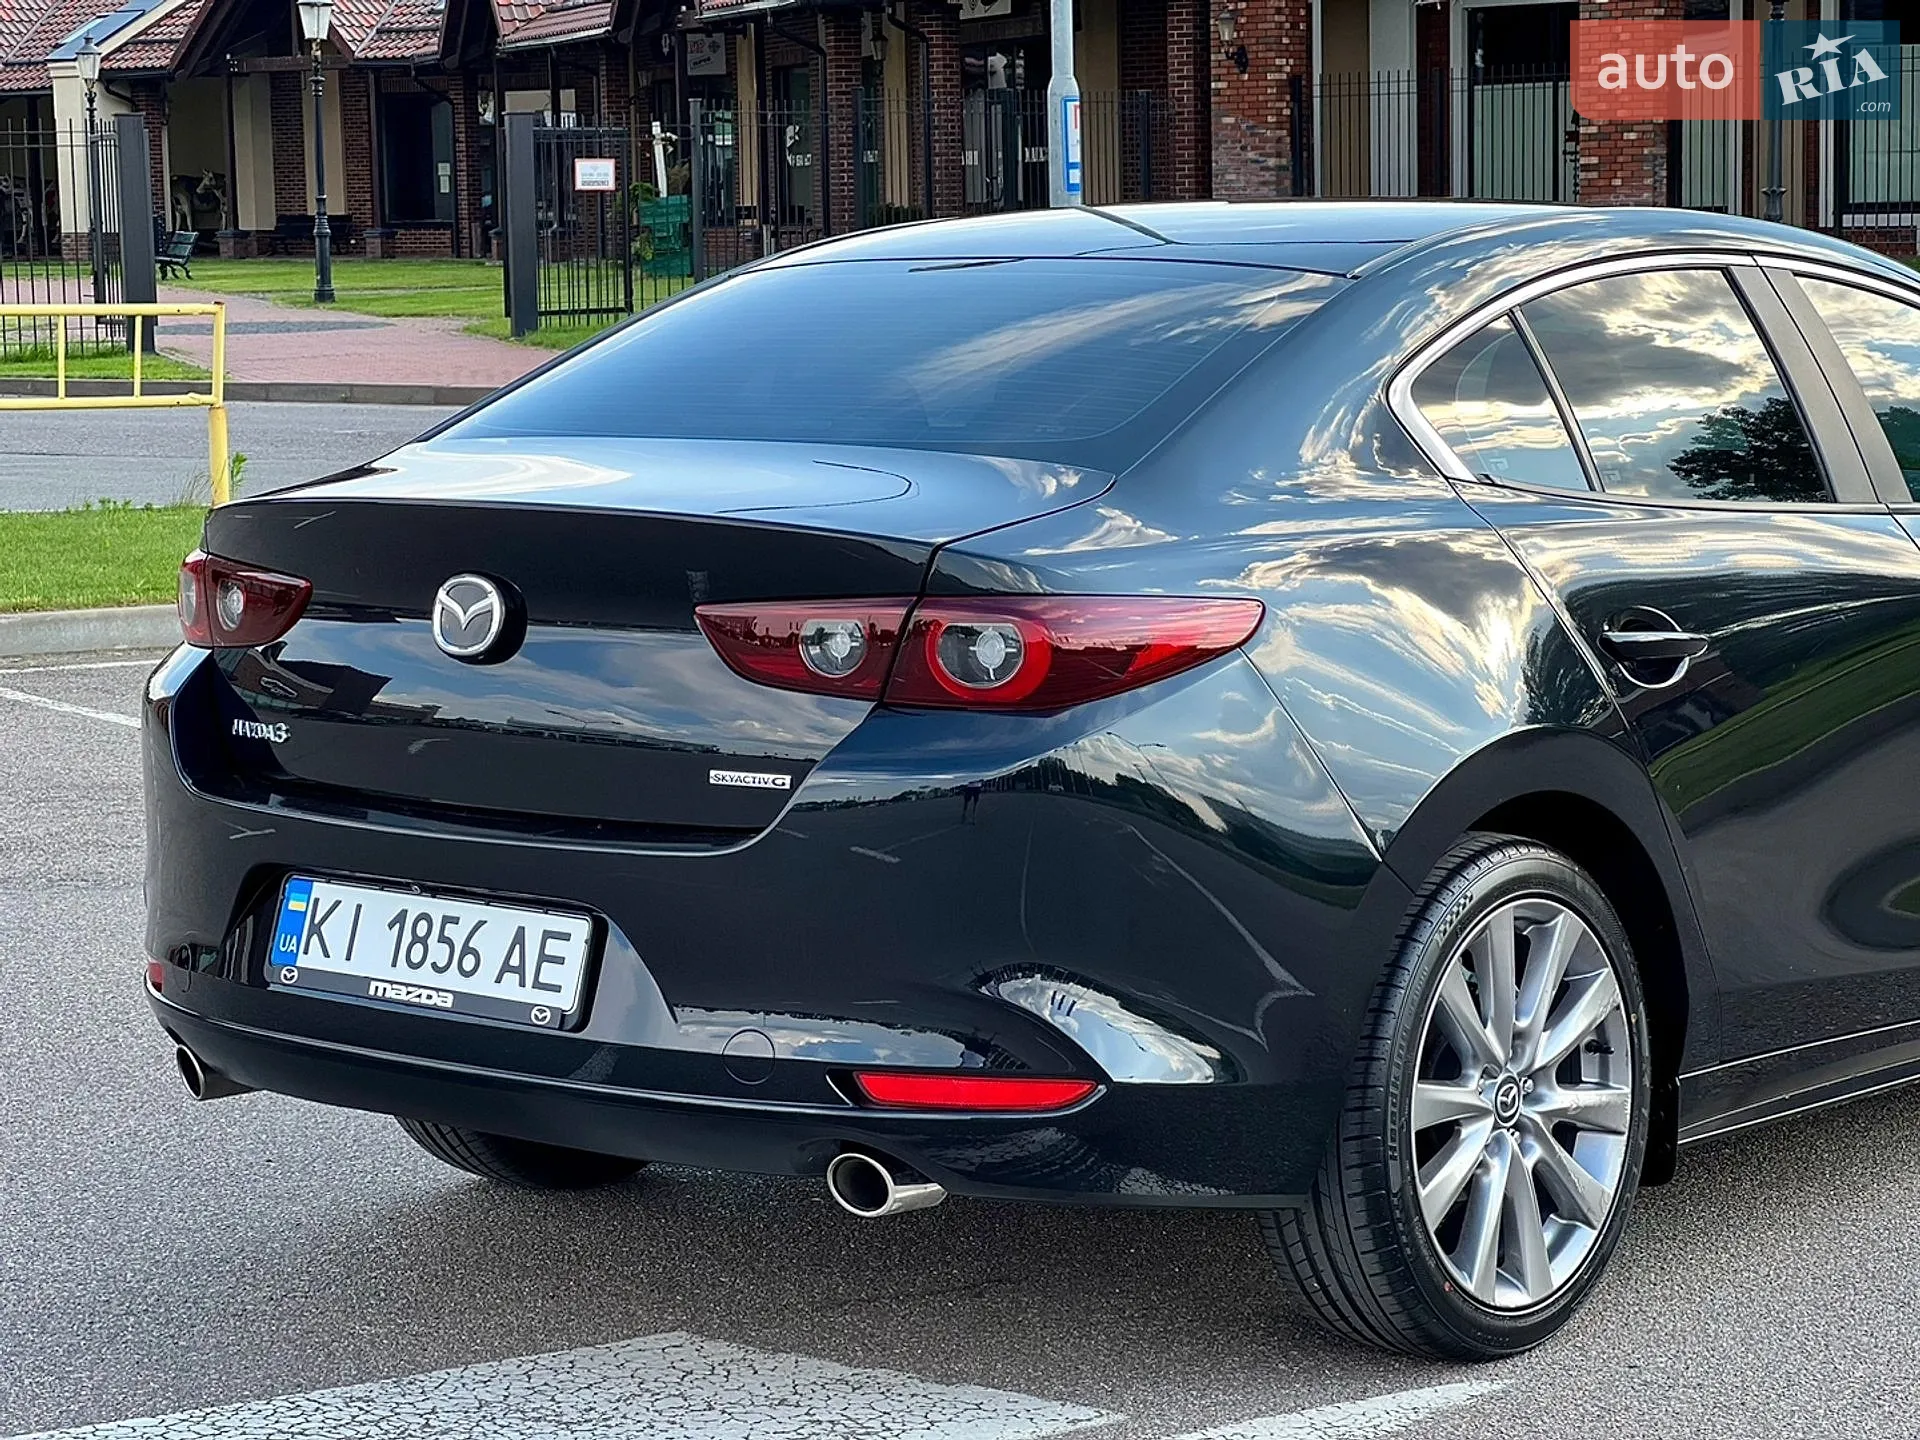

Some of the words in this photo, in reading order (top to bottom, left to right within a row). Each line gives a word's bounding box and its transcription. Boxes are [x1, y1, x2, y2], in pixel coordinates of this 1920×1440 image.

[279, 933, 298, 954] UA
[302, 897, 362, 961] KI
[387, 908, 488, 979] 1856
[494, 925, 572, 994] AE
[367, 979, 455, 1009] mazda
